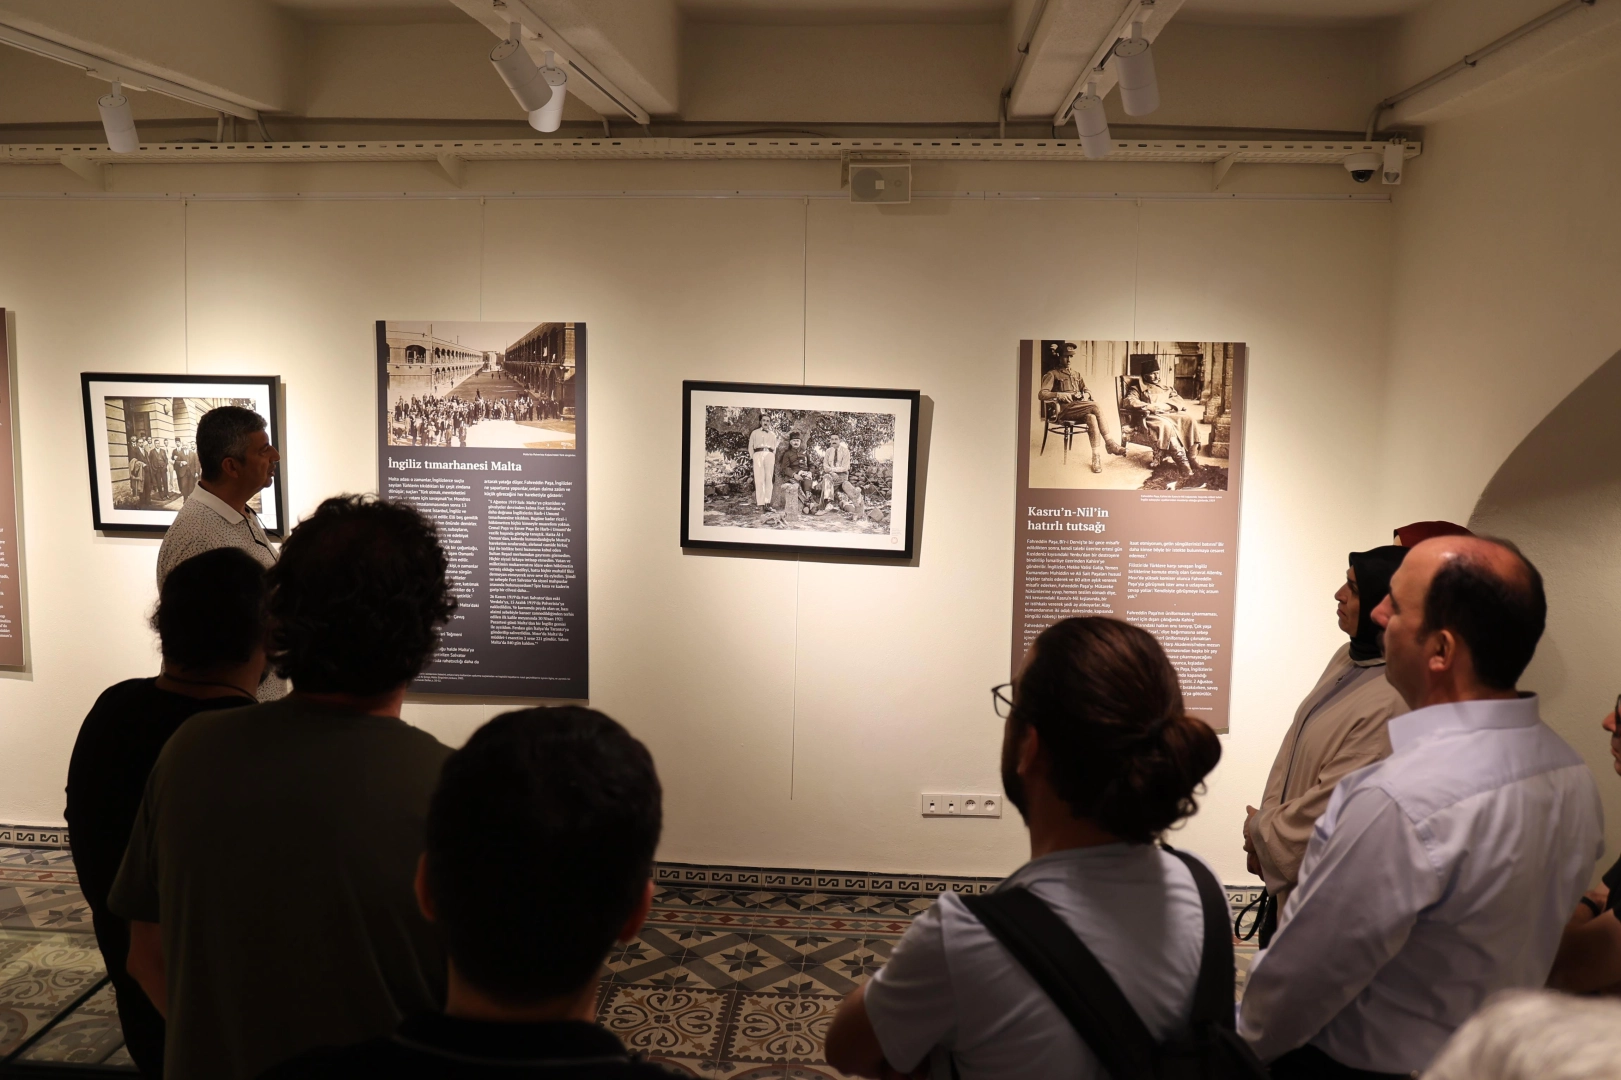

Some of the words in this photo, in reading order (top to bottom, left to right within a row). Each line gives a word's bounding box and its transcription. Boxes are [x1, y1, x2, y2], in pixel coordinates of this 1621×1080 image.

[388, 456, 422, 470] İngiliz
[424, 460, 488, 471] tımarhanesi
[491, 461, 522, 472] Malta
[1028, 506, 1110, 518] Kasru'n-Nil'in
[1027, 520, 1064, 531] hatırlı
[1066, 520, 1106, 533] tutsağı
